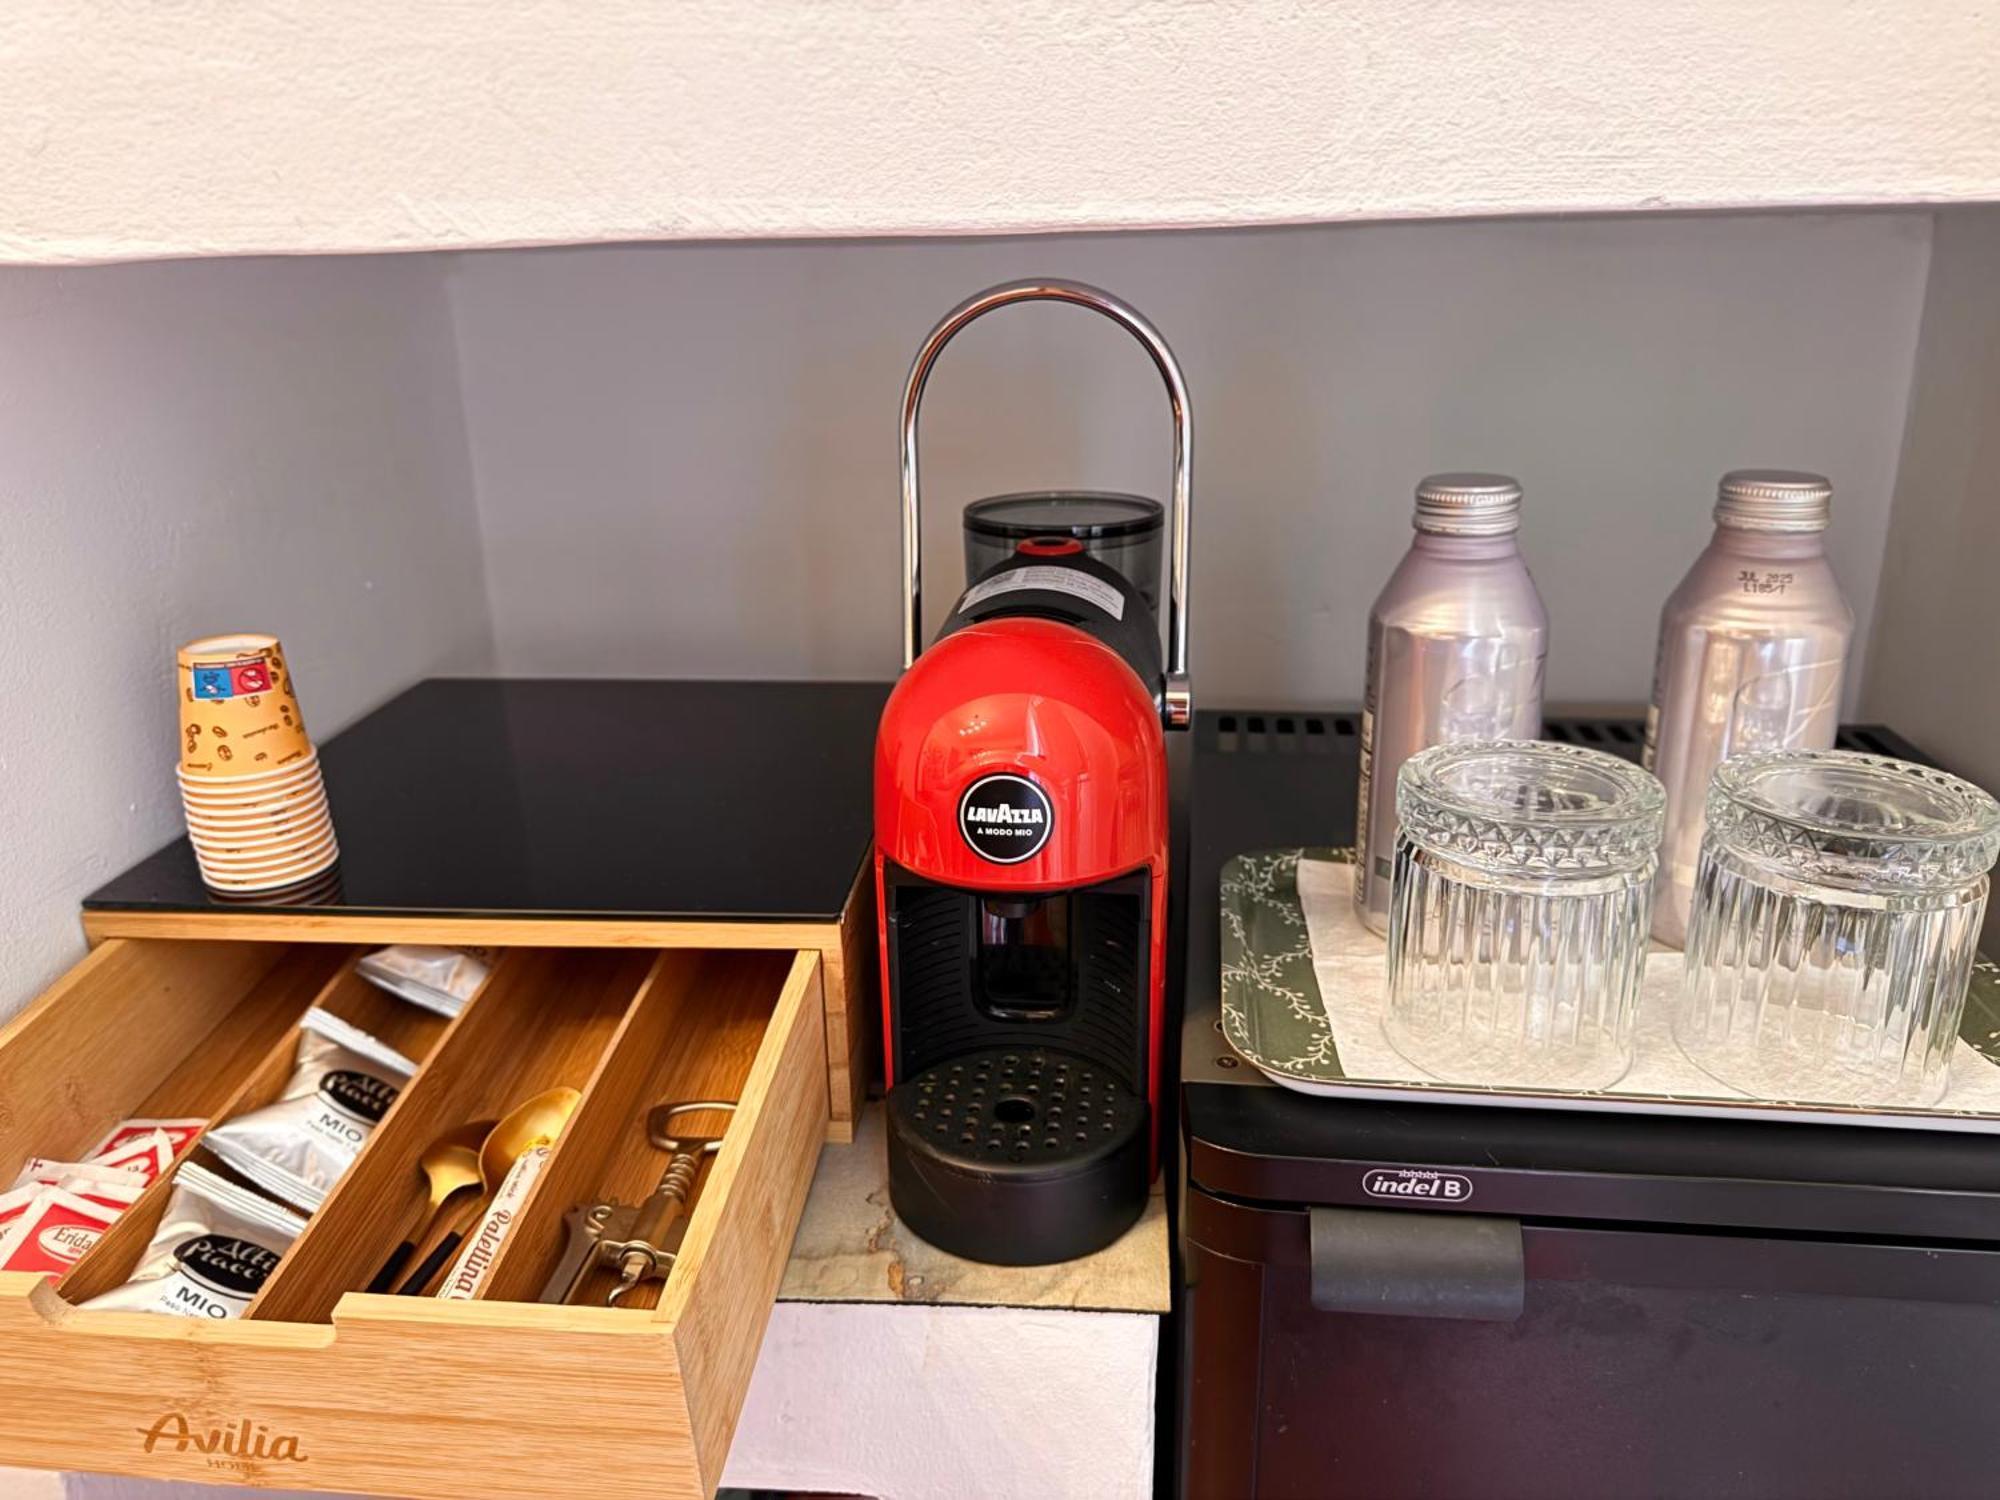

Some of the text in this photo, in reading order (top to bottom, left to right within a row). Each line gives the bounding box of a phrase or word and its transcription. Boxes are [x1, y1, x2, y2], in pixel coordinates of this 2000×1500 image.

[967, 803, 1044, 824] LAVAZZA
[976, 826, 1033, 837] A MODO MIO
[319, 1113, 363, 1142] MIO
[1372, 1175, 1462, 1198] indel B
[216, 1239, 277, 1271] Alti
[454, 1208, 513, 1294] Palettina
[176, 1286, 228, 1320] MIO
[135, 1411, 310, 1463] Avilia
